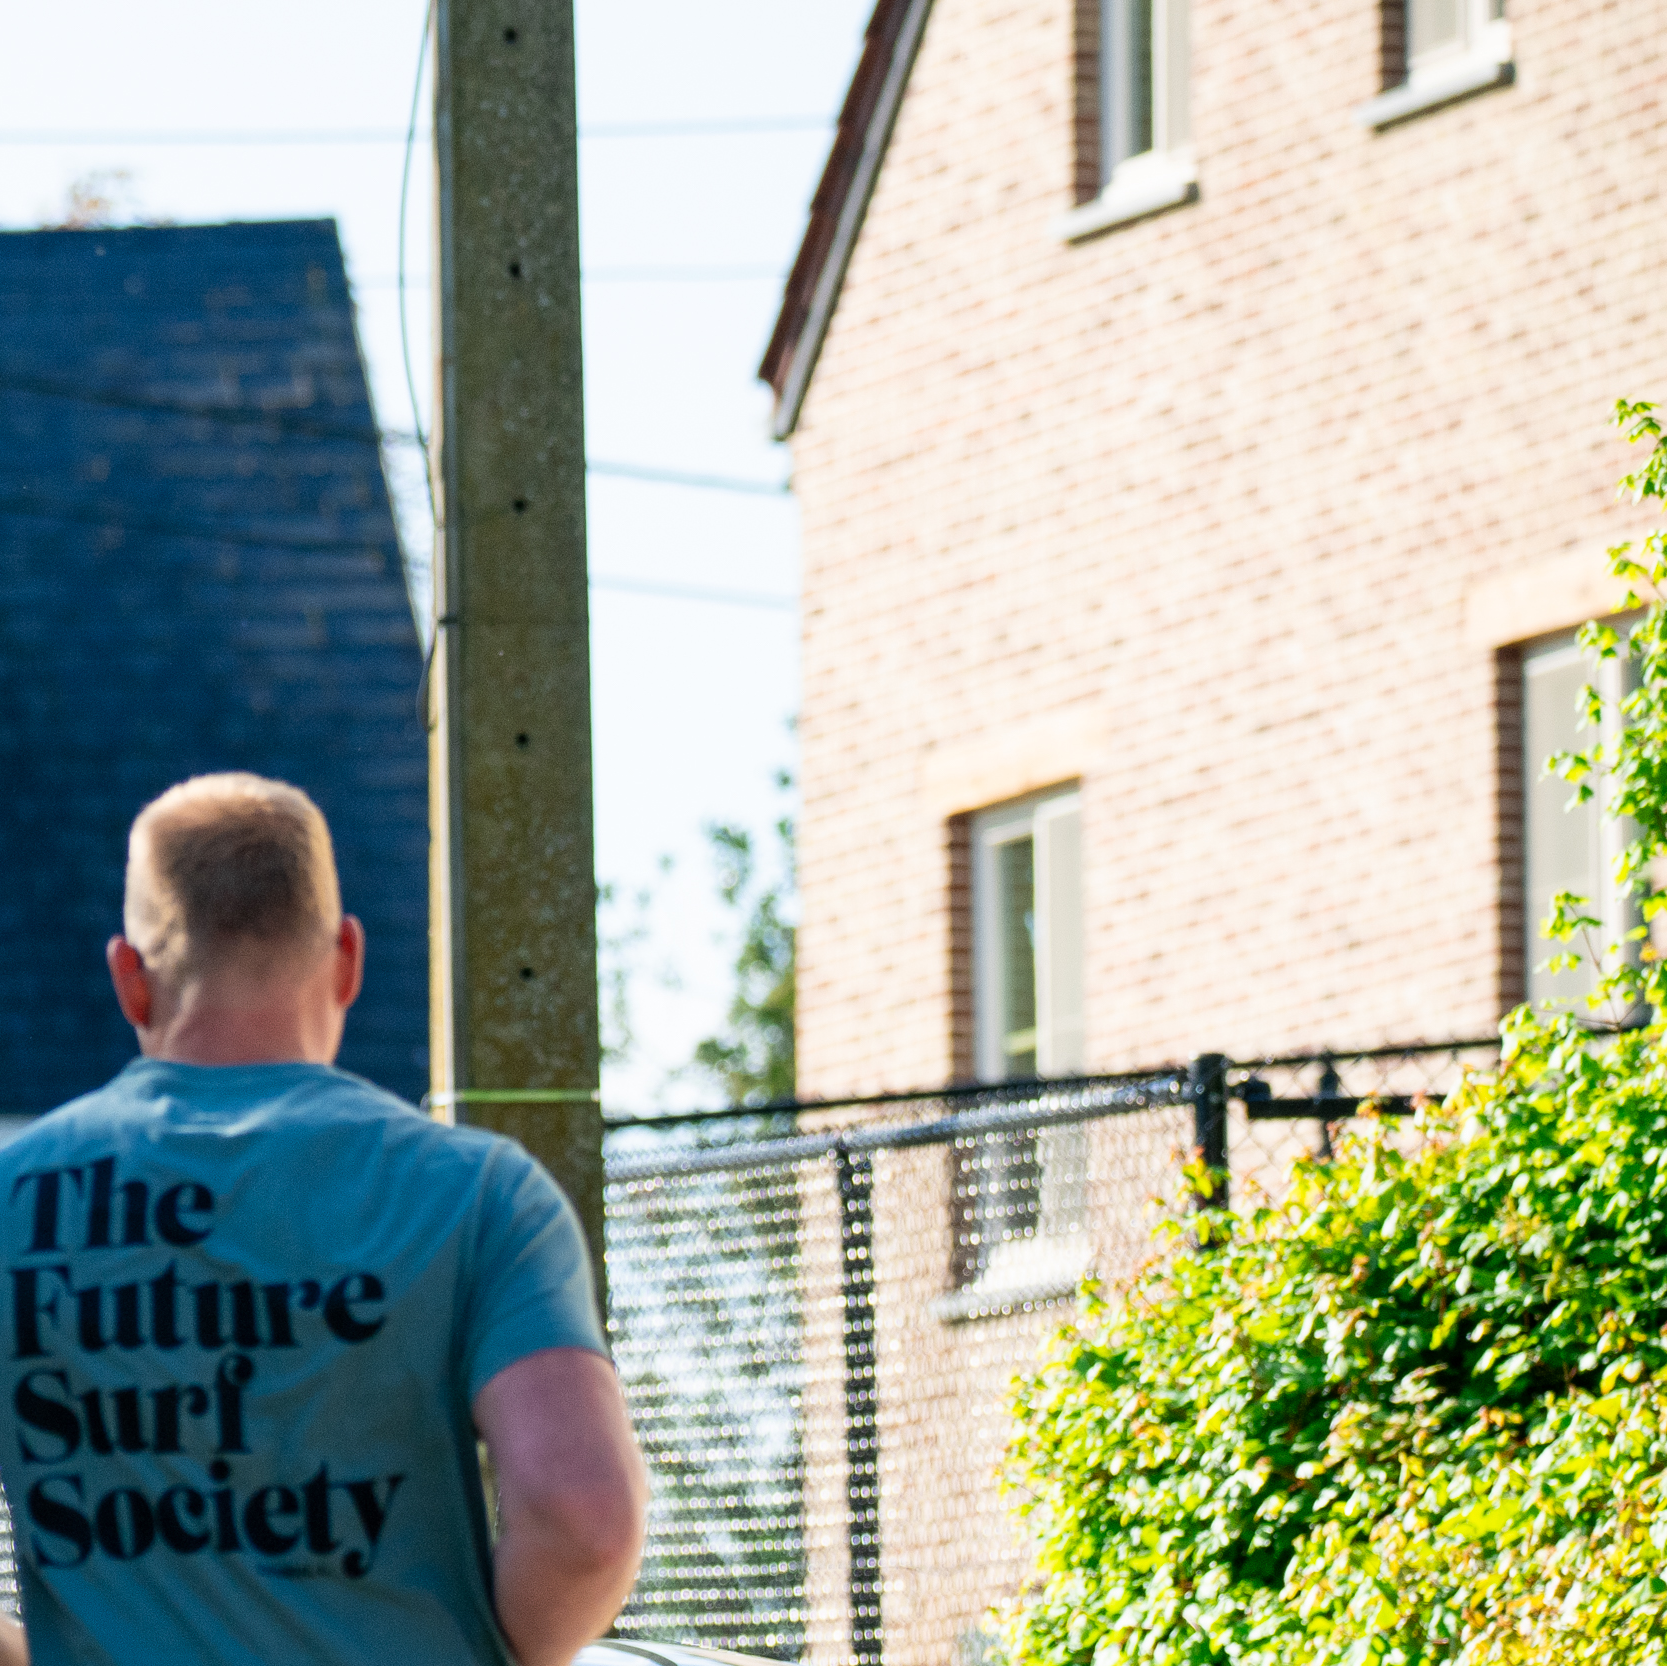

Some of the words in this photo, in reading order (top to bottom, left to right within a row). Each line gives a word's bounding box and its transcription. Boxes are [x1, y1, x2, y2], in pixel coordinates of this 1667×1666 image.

[10, 1155, 216, 1256] The
[9, 1259, 388, 1361] Future
[13, 1352, 255, 1465] Surf
[26, 1459, 408, 1579] Society
